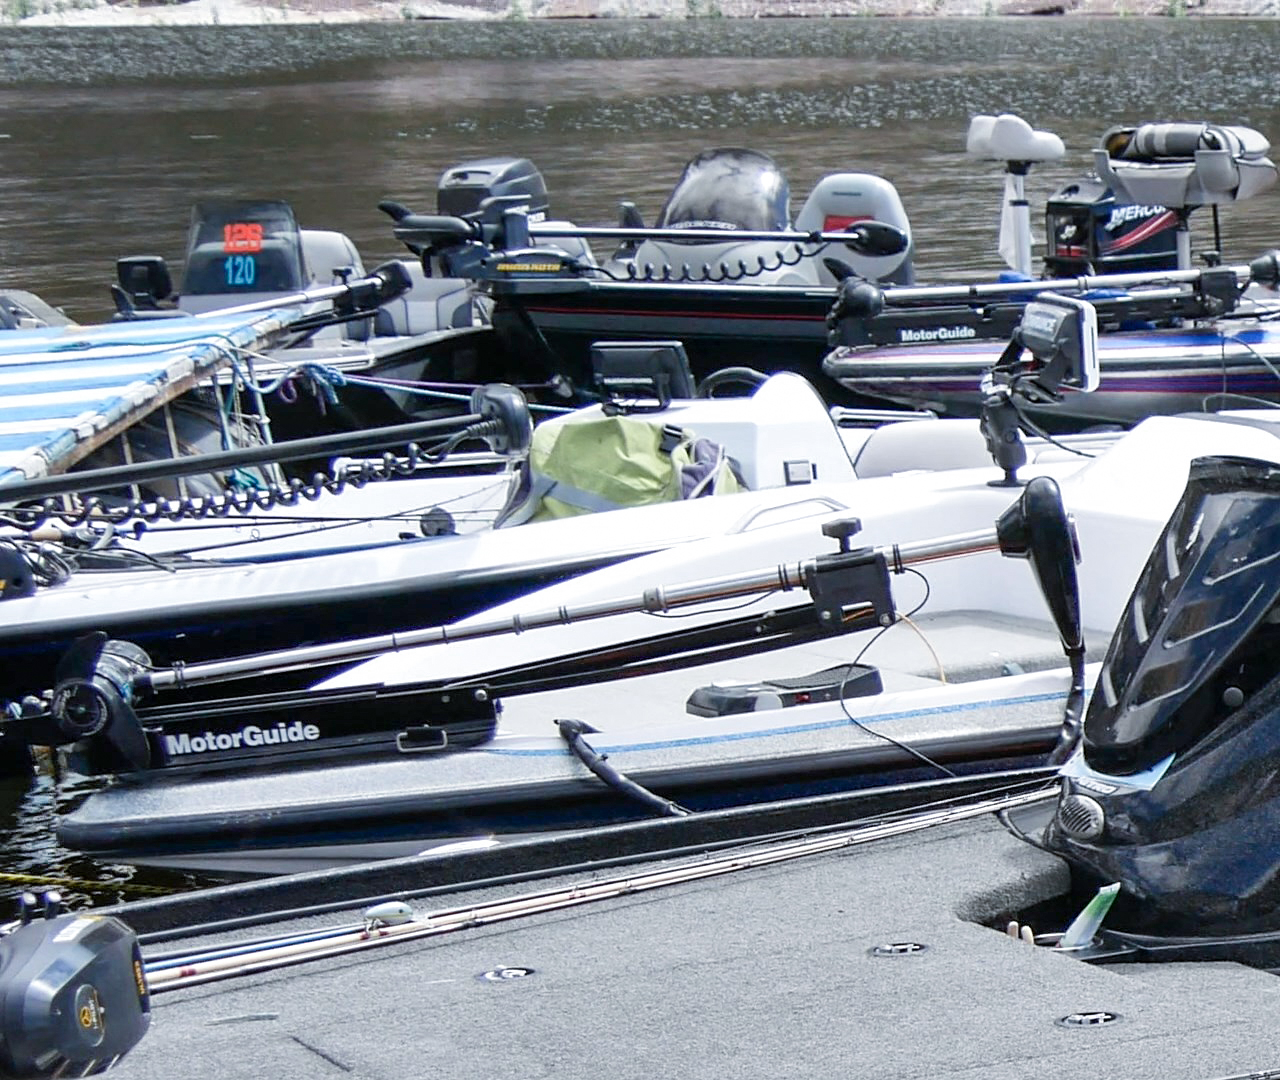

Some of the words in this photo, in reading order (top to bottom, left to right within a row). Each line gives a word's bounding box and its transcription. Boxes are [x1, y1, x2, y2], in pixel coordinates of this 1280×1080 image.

[1105, 205, 1167, 230] MERCU
[224, 255, 255, 285] 120
[901, 327, 976, 342] MotorGuide
[166, 720, 321, 757] MotorGuide
